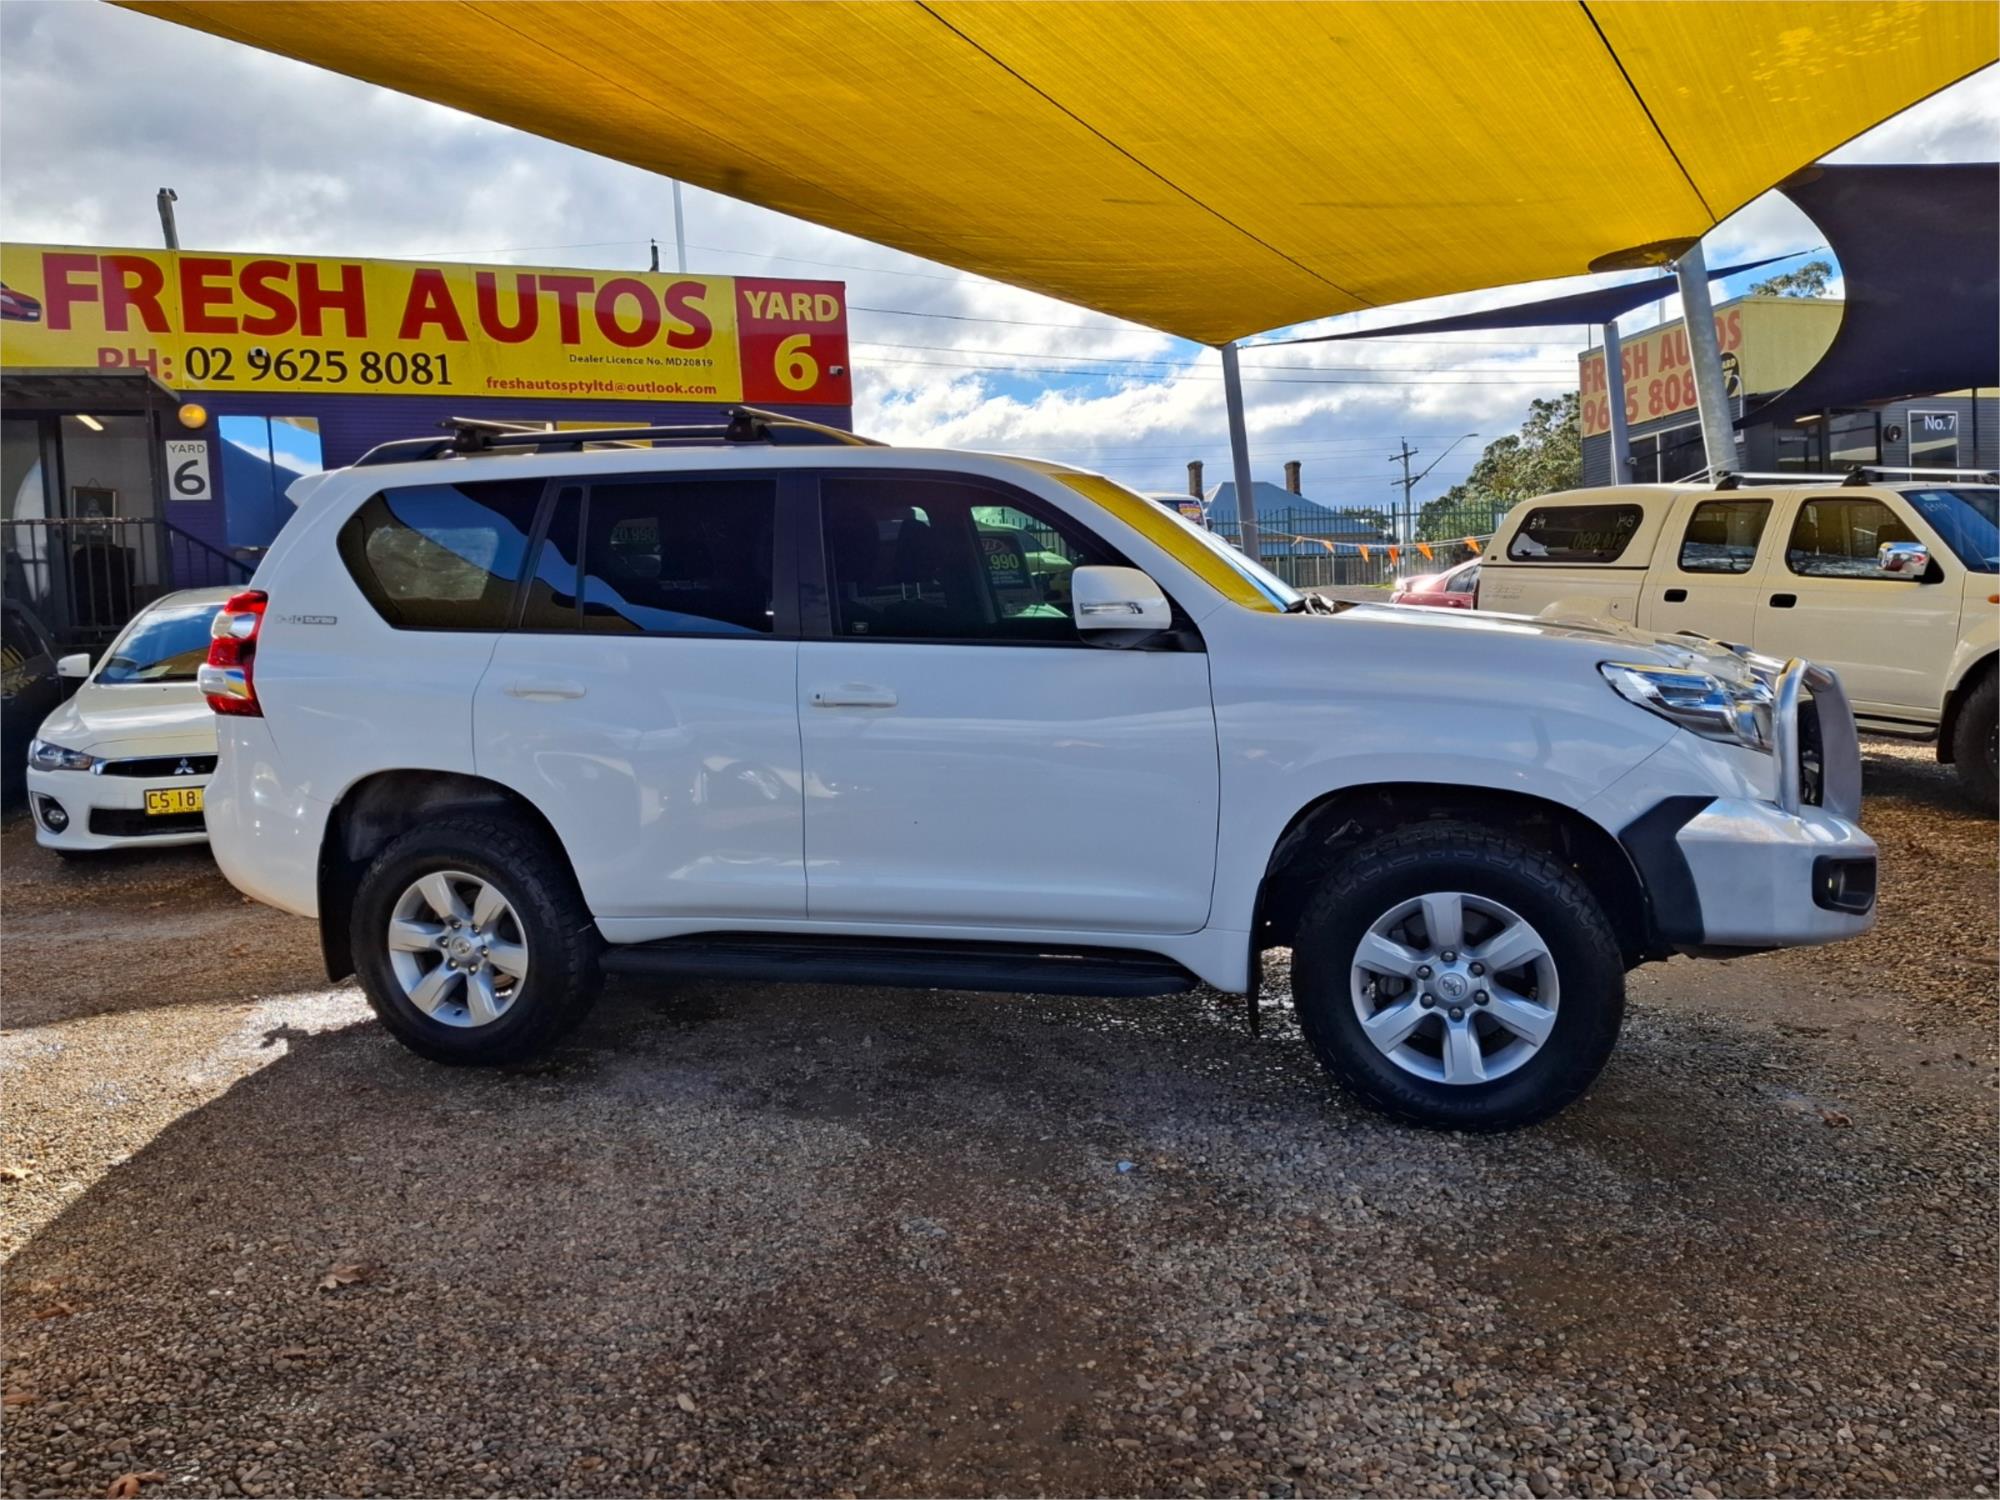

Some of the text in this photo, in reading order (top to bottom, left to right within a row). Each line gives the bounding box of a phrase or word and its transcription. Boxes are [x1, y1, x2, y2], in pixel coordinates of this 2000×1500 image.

[42, 252, 713, 349] FRESH AUTOS
[744, 290, 840, 323] YARD
[185, 346, 235, 382] 02
[247, 347, 348, 384] 9625
[360, 350, 453, 387] 8081
[569, 354, 713, 367] Dealer Licence No. MD20819
[774, 333, 819, 392] 6
[1580, 341, 1649, 396] FRSH
[486, 376, 717, 395] freshautosptyltd@outlook.com
[1583, 385, 1639, 434] 965
[169, 444, 205, 454] YARD
[174, 459, 206, 495] 6
